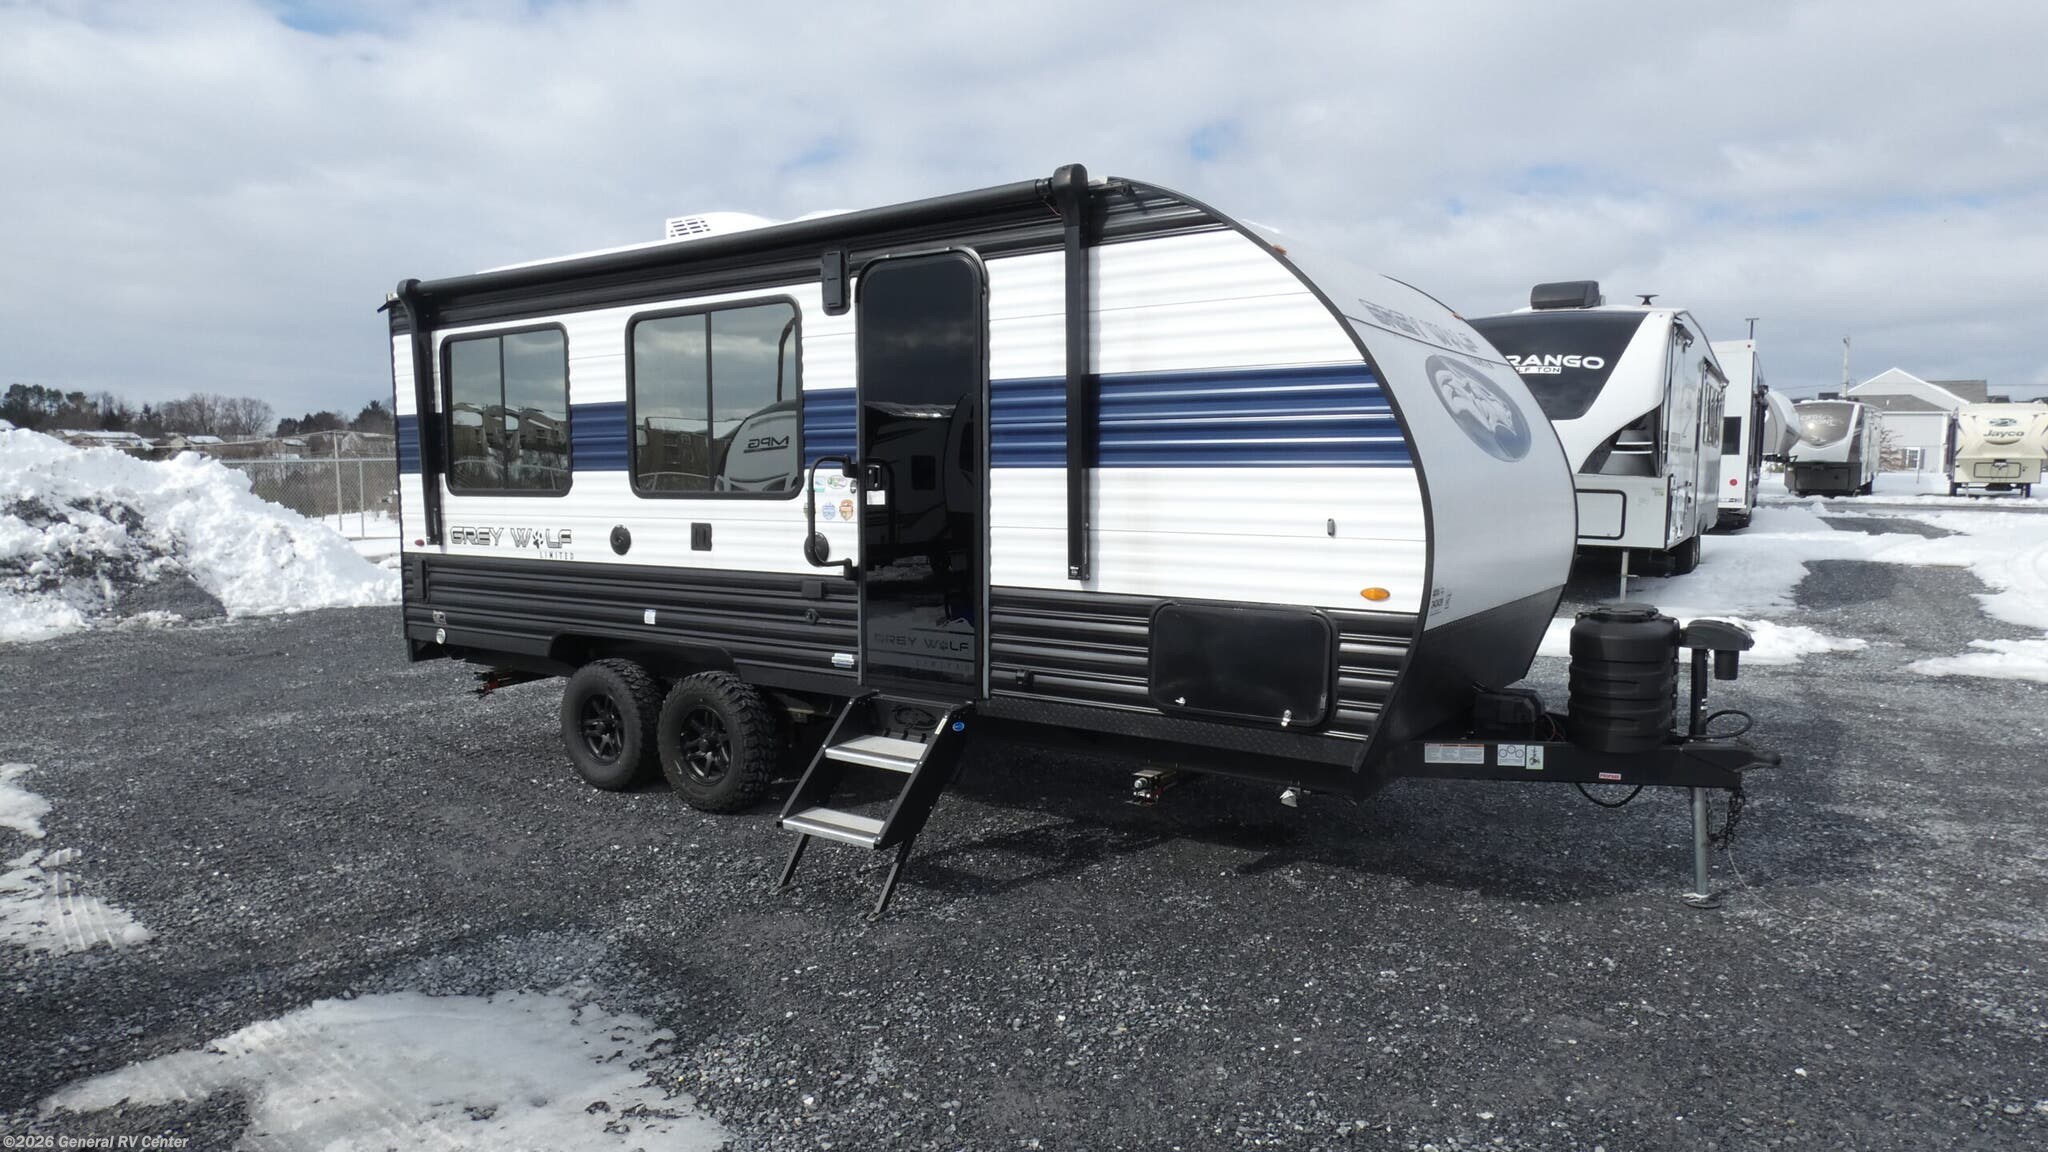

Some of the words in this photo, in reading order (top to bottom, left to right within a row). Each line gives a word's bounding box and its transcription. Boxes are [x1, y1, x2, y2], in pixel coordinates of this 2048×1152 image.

[1505, 354, 1605, 370] RANGO
[1983, 429, 2025, 438] Jayco
[450, 525, 504, 546] GREY
[539, 550, 575, 560] LIMITED
